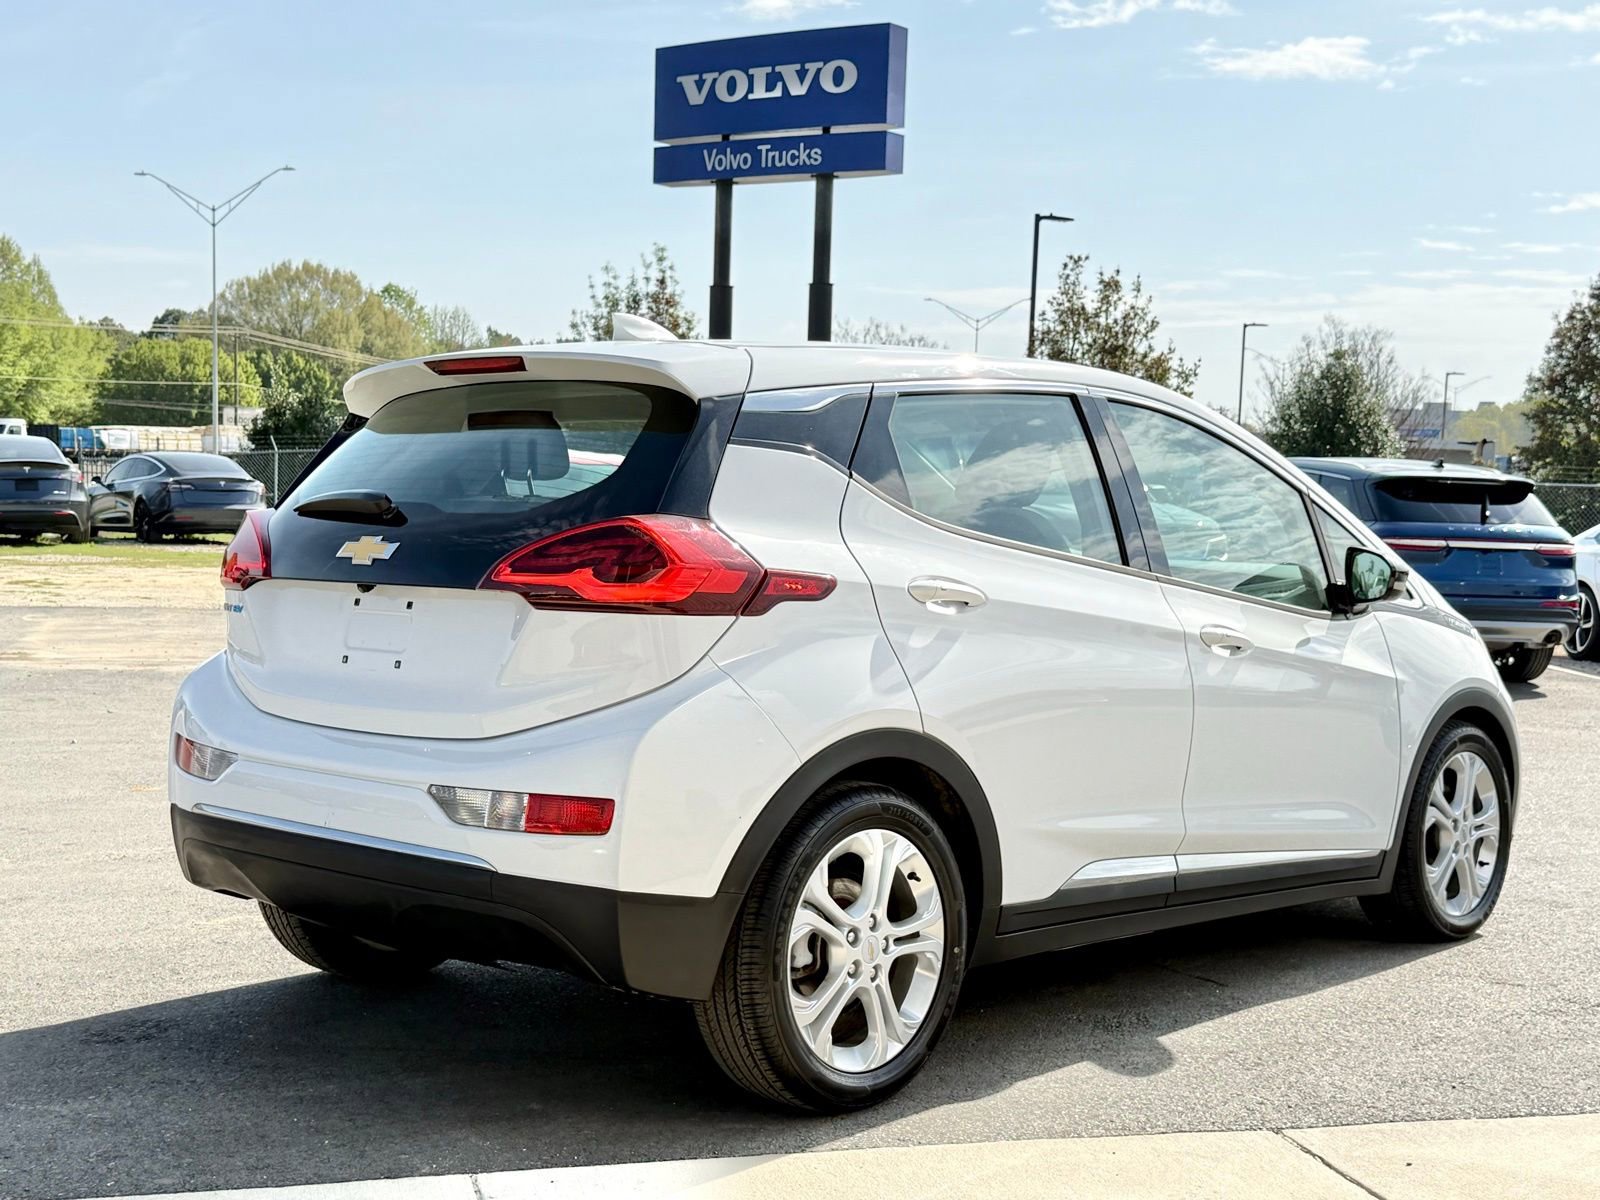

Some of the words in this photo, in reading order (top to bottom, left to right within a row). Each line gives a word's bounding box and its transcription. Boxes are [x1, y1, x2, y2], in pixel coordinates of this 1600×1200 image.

[676, 59, 858, 106] VOLVO
[703, 147, 752, 172] Volvo
[757, 142, 823, 168] Trucks
